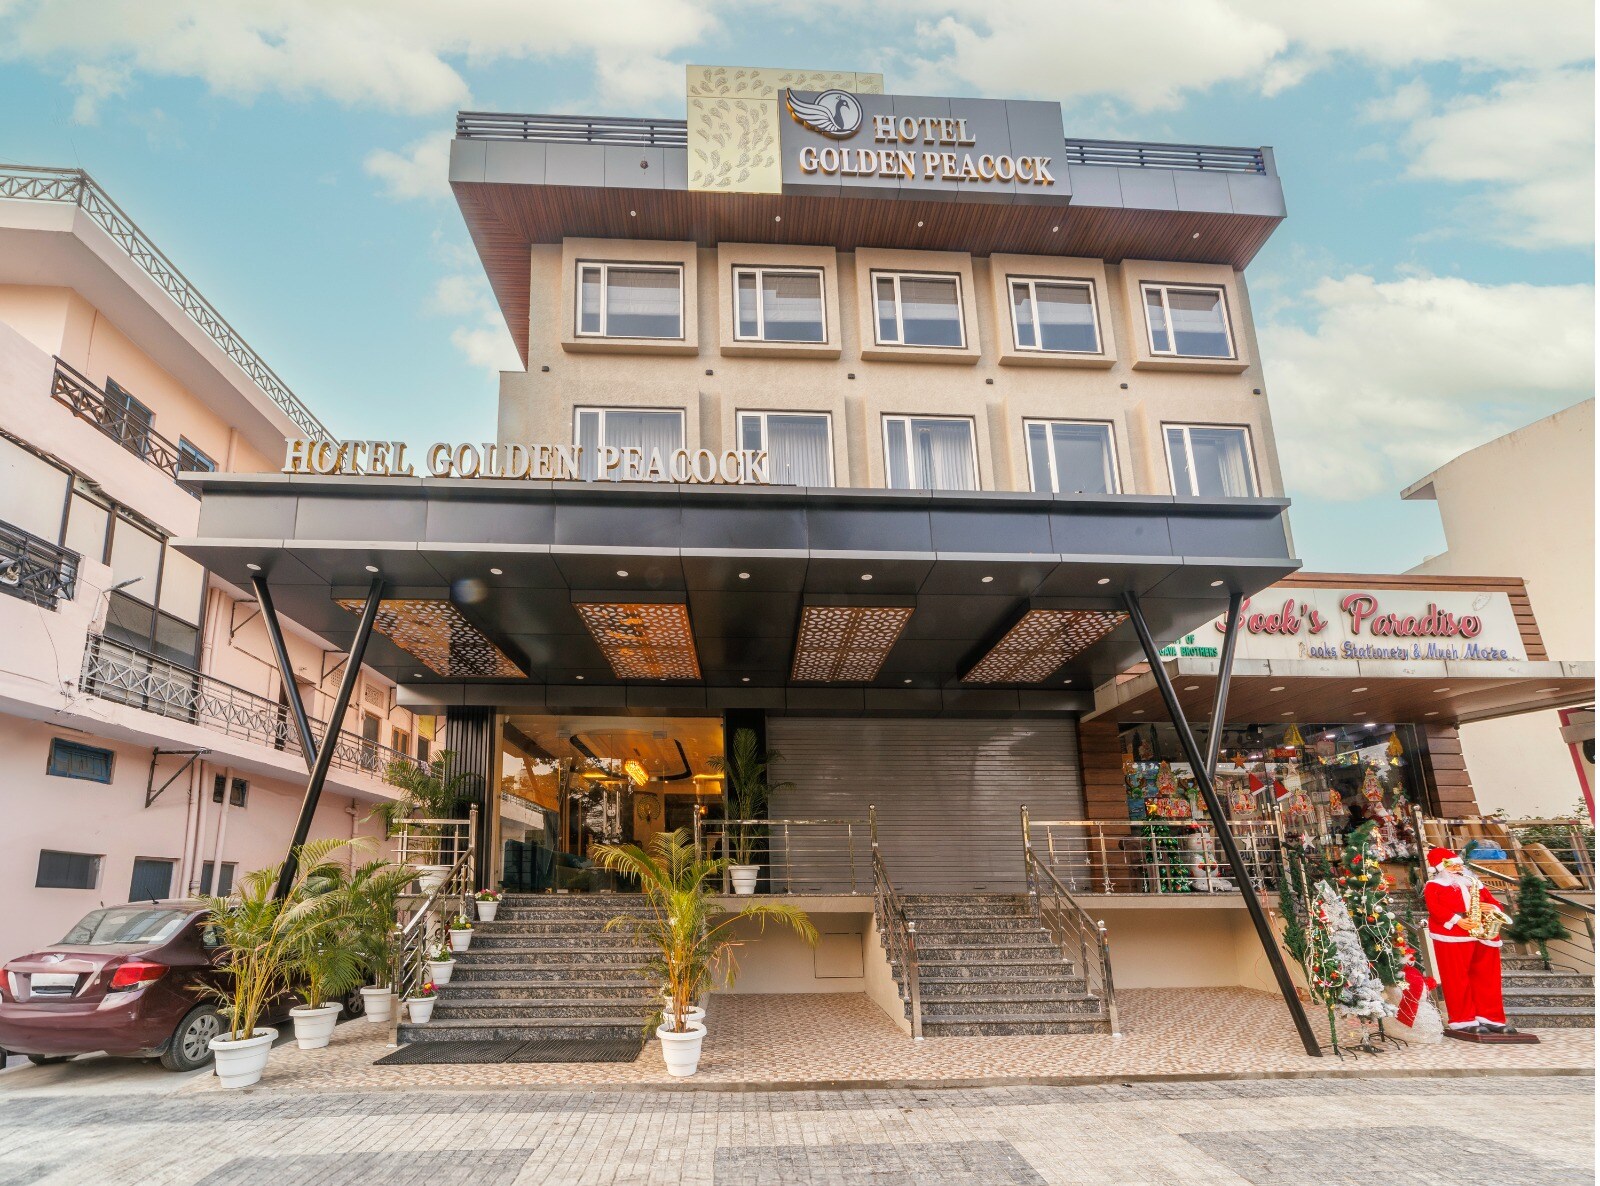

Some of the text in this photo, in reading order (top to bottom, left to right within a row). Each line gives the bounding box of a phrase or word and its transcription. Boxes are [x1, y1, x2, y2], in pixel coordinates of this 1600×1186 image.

[873, 114, 976, 146] HOTEL
[799, 146, 1055, 185] GOLDEN PEACOCK
[281, 437, 771, 485] HOTEL GOLDEN PEACOCK
[1341, 593, 1482, 638] Paradise
[1180, 646, 1218, 657] BROTHERS
[1411, 643, 1421, 660] &
[1423, 642, 1459, 660] Much
